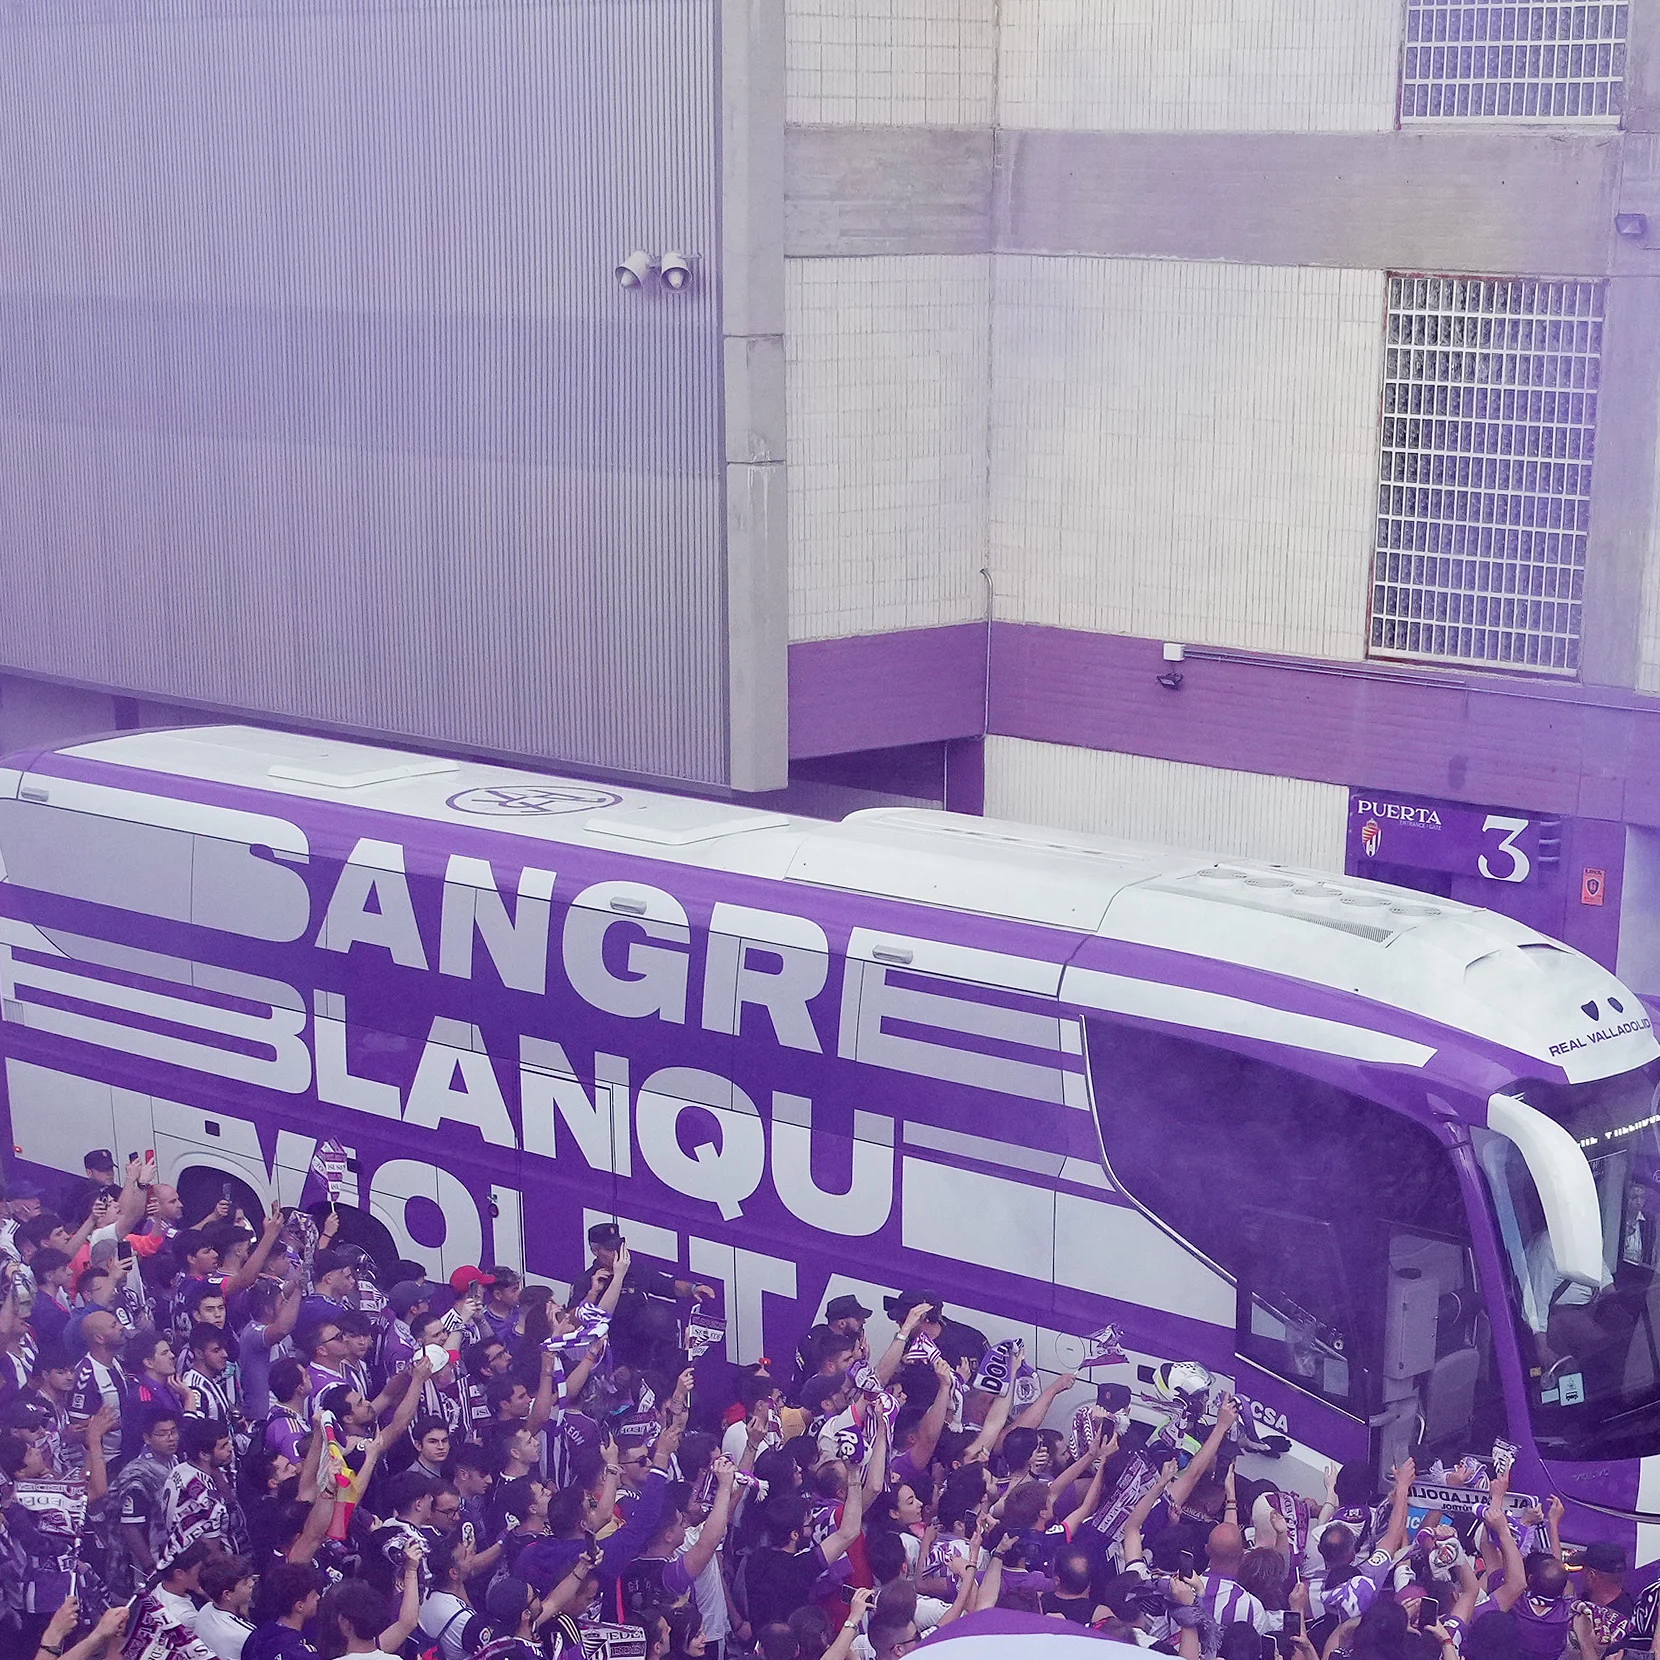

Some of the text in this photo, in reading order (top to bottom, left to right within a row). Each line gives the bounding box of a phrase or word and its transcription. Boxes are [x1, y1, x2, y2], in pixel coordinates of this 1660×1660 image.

[1357, 799, 1530, 883] PUERTA 3
[130, 785, 1088, 1110] SANGRE
[1549, 1017, 1652, 1058] REAL VALLADOLID
